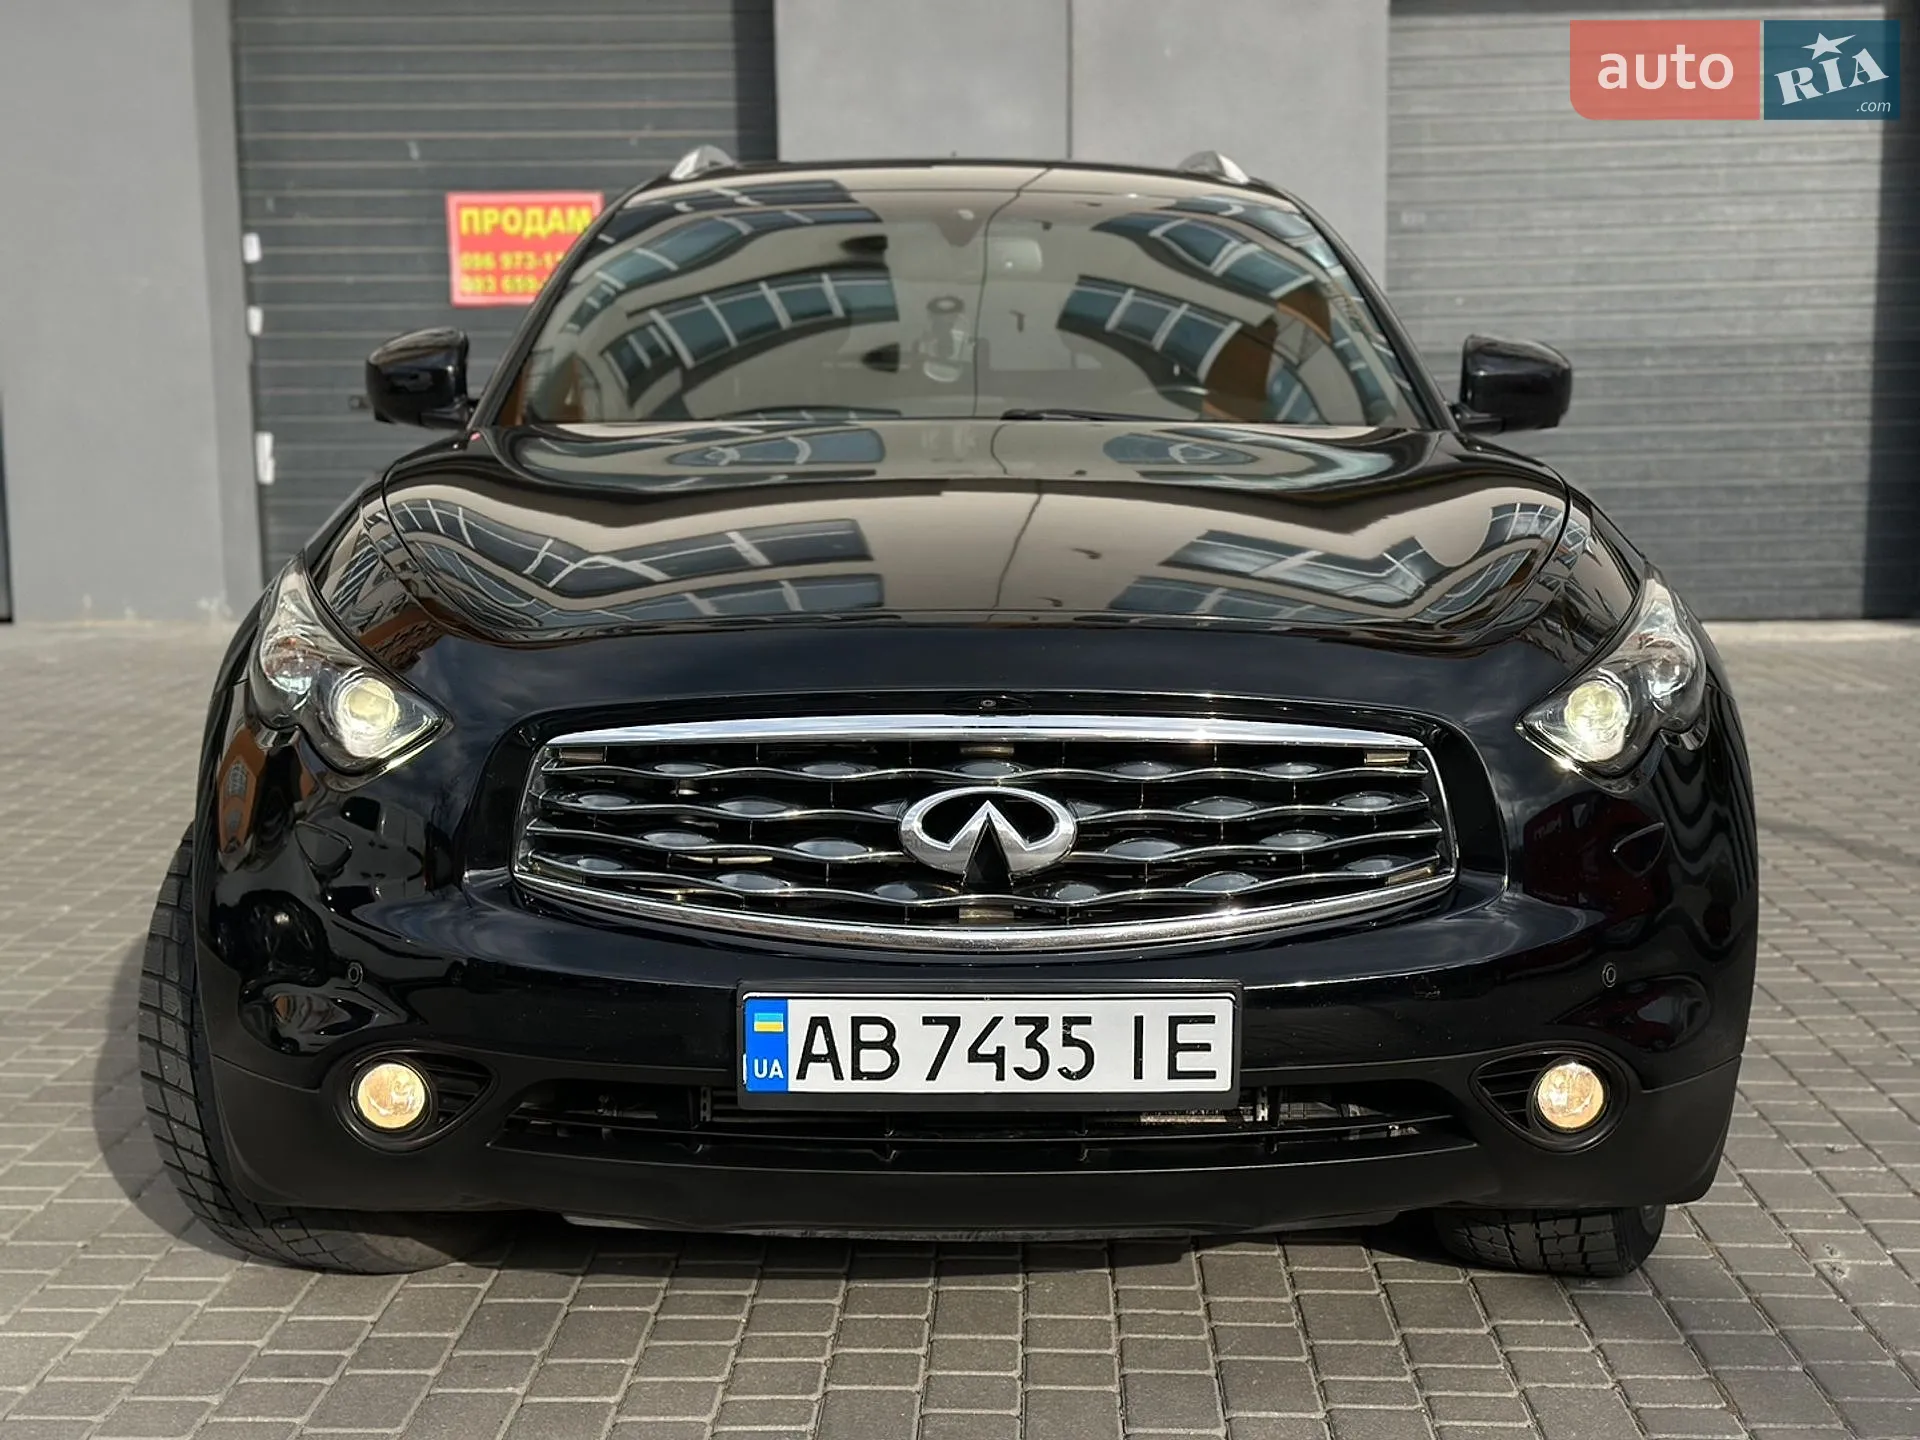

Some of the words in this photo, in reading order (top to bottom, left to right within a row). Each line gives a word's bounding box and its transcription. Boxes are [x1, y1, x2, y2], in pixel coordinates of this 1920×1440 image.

[460, 206, 593, 239] ПРОДАМ
[796, 1016, 900, 1081] AB
[922, 1016, 1095, 1082] 7435
[1133, 1015, 1218, 1081] IE
[753, 1058, 785, 1080] UA
